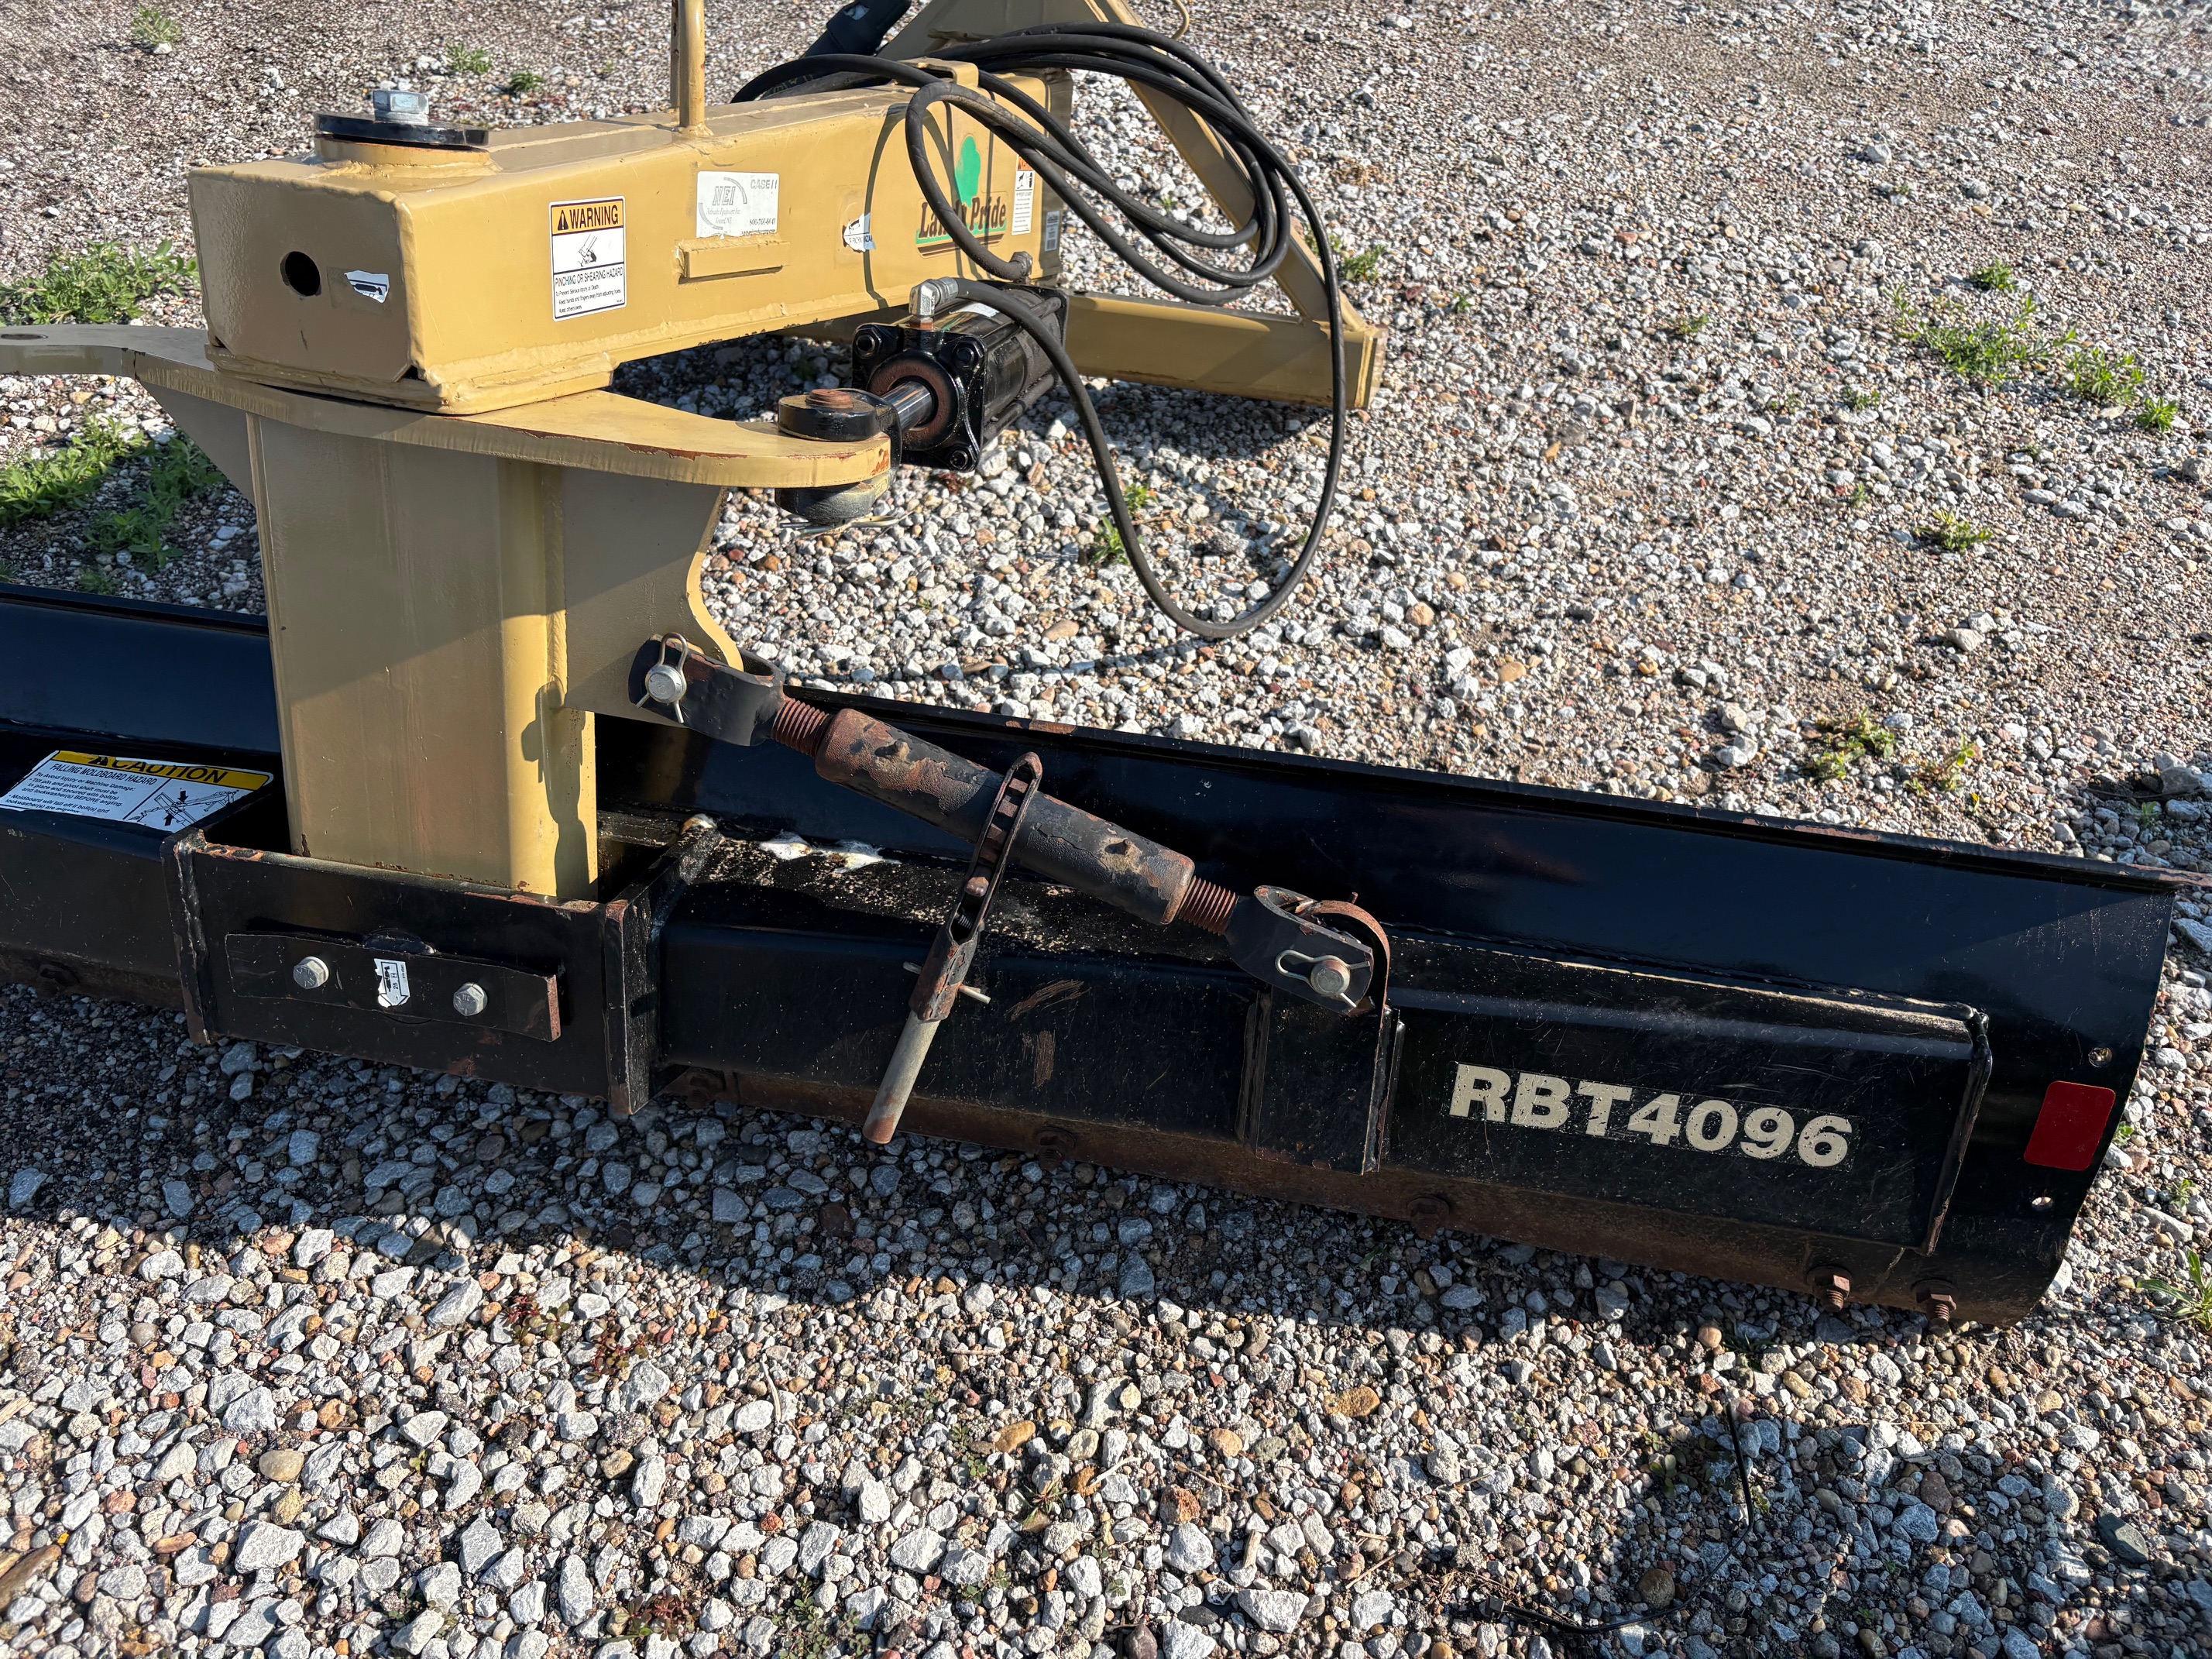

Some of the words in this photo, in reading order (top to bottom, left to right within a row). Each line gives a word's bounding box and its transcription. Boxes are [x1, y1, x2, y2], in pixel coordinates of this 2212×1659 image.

[750, 179, 771, 190] CASE
[712, 185, 737, 206] NEI
[569, 204, 619, 229] WARNING
[969, 196, 1006, 232] Pride
[555, 274, 576, 287] PINCHING
[576, 273, 583, 283] OR
[584, 270, 606, 282] SHEARING
[606, 266, 623, 278] HAZARD
[50, 763, 83, 774] FALLING
[80, 768, 125, 781] MOLDBOARD
[125, 775, 158, 785] HAZARD
[112, 759, 229, 784] CAUTION
[12, 794, 44, 802] Moldboard
[34, 788, 74, 799] lockwasher(s)
[74, 795, 100, 803] BEFORE
[99, 792, 119, 801] bolt(s)
[110, 783, 136, 792] Damage:
[5, 799, 46, 809] lockwasher(s)
[1448, 1062, 1853, 1168] RBT4096
